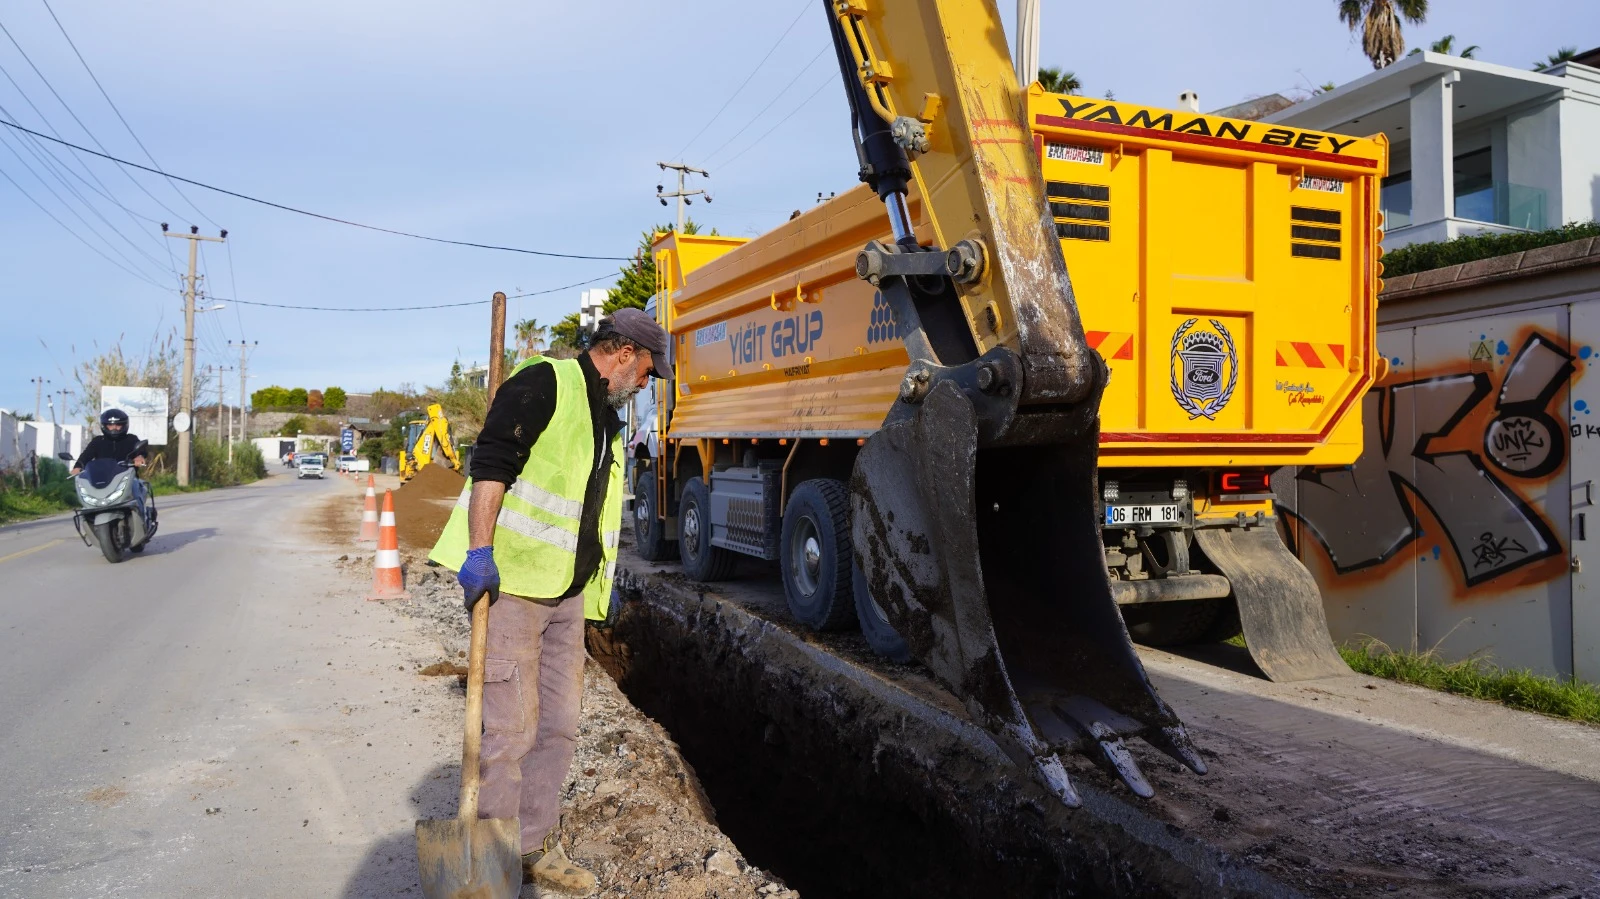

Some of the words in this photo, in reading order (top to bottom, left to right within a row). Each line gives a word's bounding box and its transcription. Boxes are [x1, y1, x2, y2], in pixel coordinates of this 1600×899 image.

[1058, 99, 1251, 140] YAMAN
[1261, 129, 1357, 154] BEY
[729, 321, 767, 366] YİĞİT
[771, 309, 824, 358] GRUP
[1192, 369, 1214, 383] Ford
[1493, 430, 1544, 452] UNK
[1113, 508, 1126, 522] 06
[1132, 507, 1152, 521] FRM
[1161, 506, 1176, 521] 181
